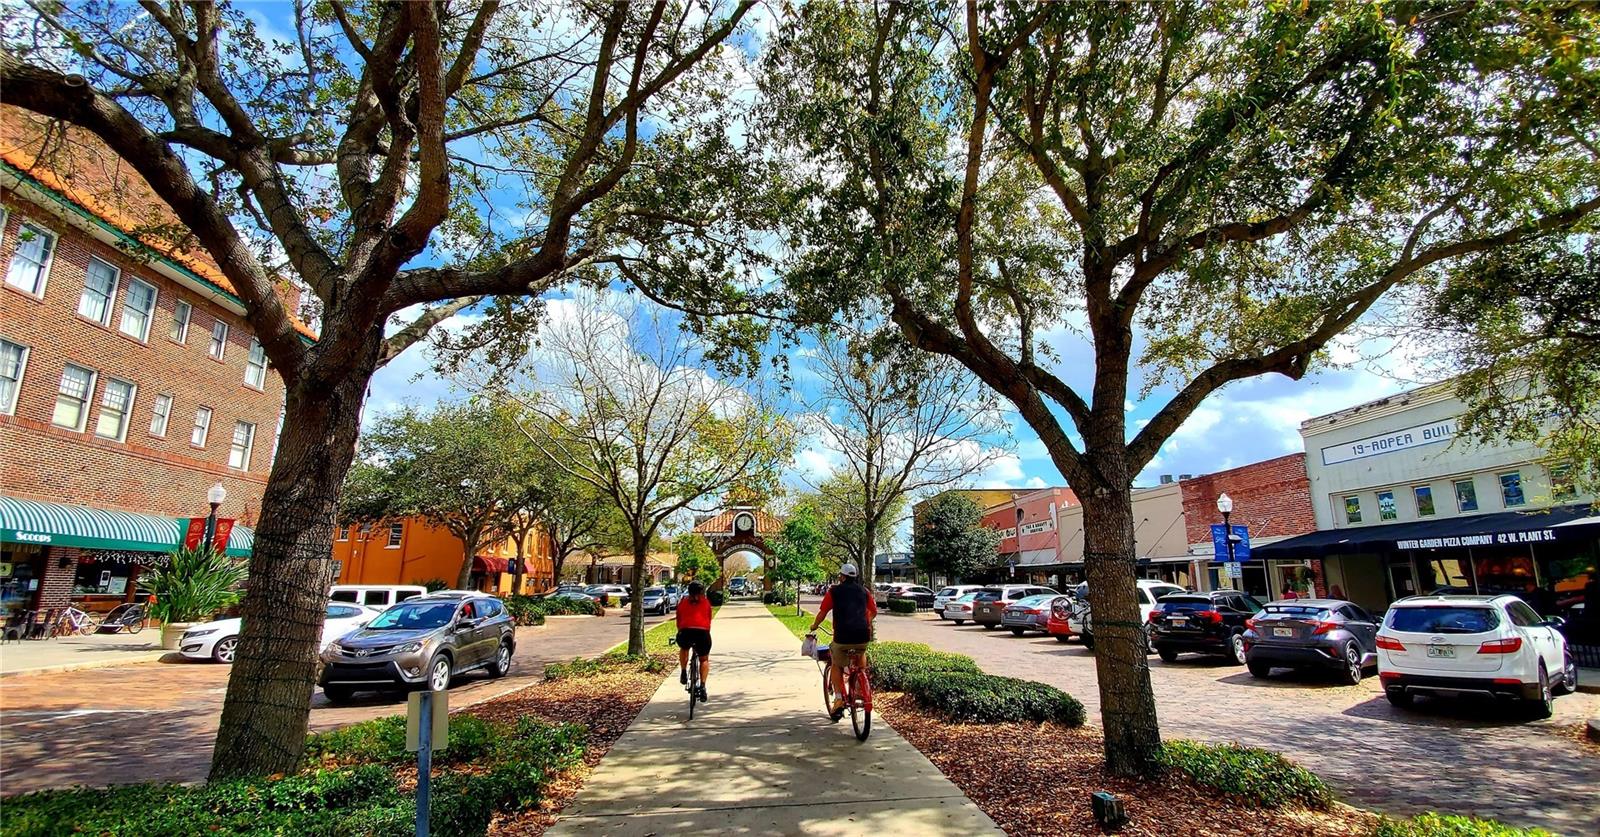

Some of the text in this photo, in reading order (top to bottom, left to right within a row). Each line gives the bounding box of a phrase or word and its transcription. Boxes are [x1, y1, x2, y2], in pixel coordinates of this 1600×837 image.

[1423, 425, 1458, 441] BUIL
[1397, 529, 1556, 550] WINTER GARDEN PIZZA COMPANY 42 W. PLANT ST.
